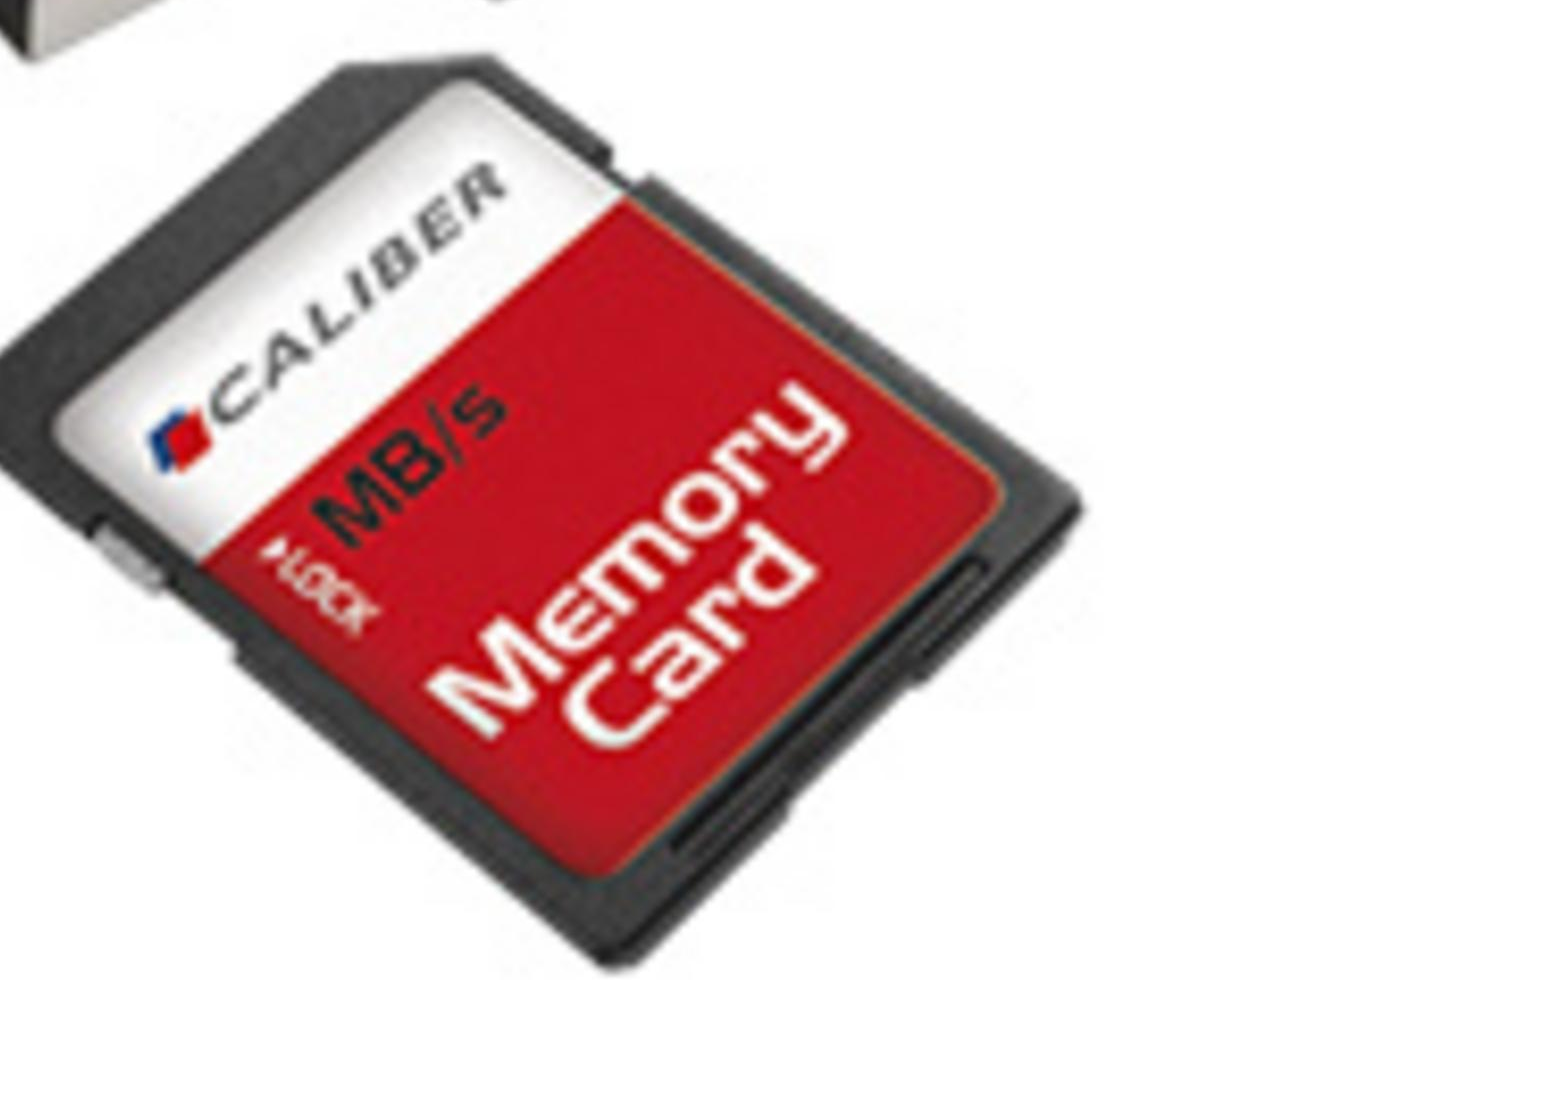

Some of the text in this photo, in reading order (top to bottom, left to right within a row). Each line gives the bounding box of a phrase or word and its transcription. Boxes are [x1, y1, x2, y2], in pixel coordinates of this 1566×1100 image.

[205, 160, 512, 432] CALIBER
[309, 382, 510, 550] MB/s
[422, 379, 852, 742] Memory
[279, 552, 382, 640] LOCK
[562, 520, 819, 751] Card
